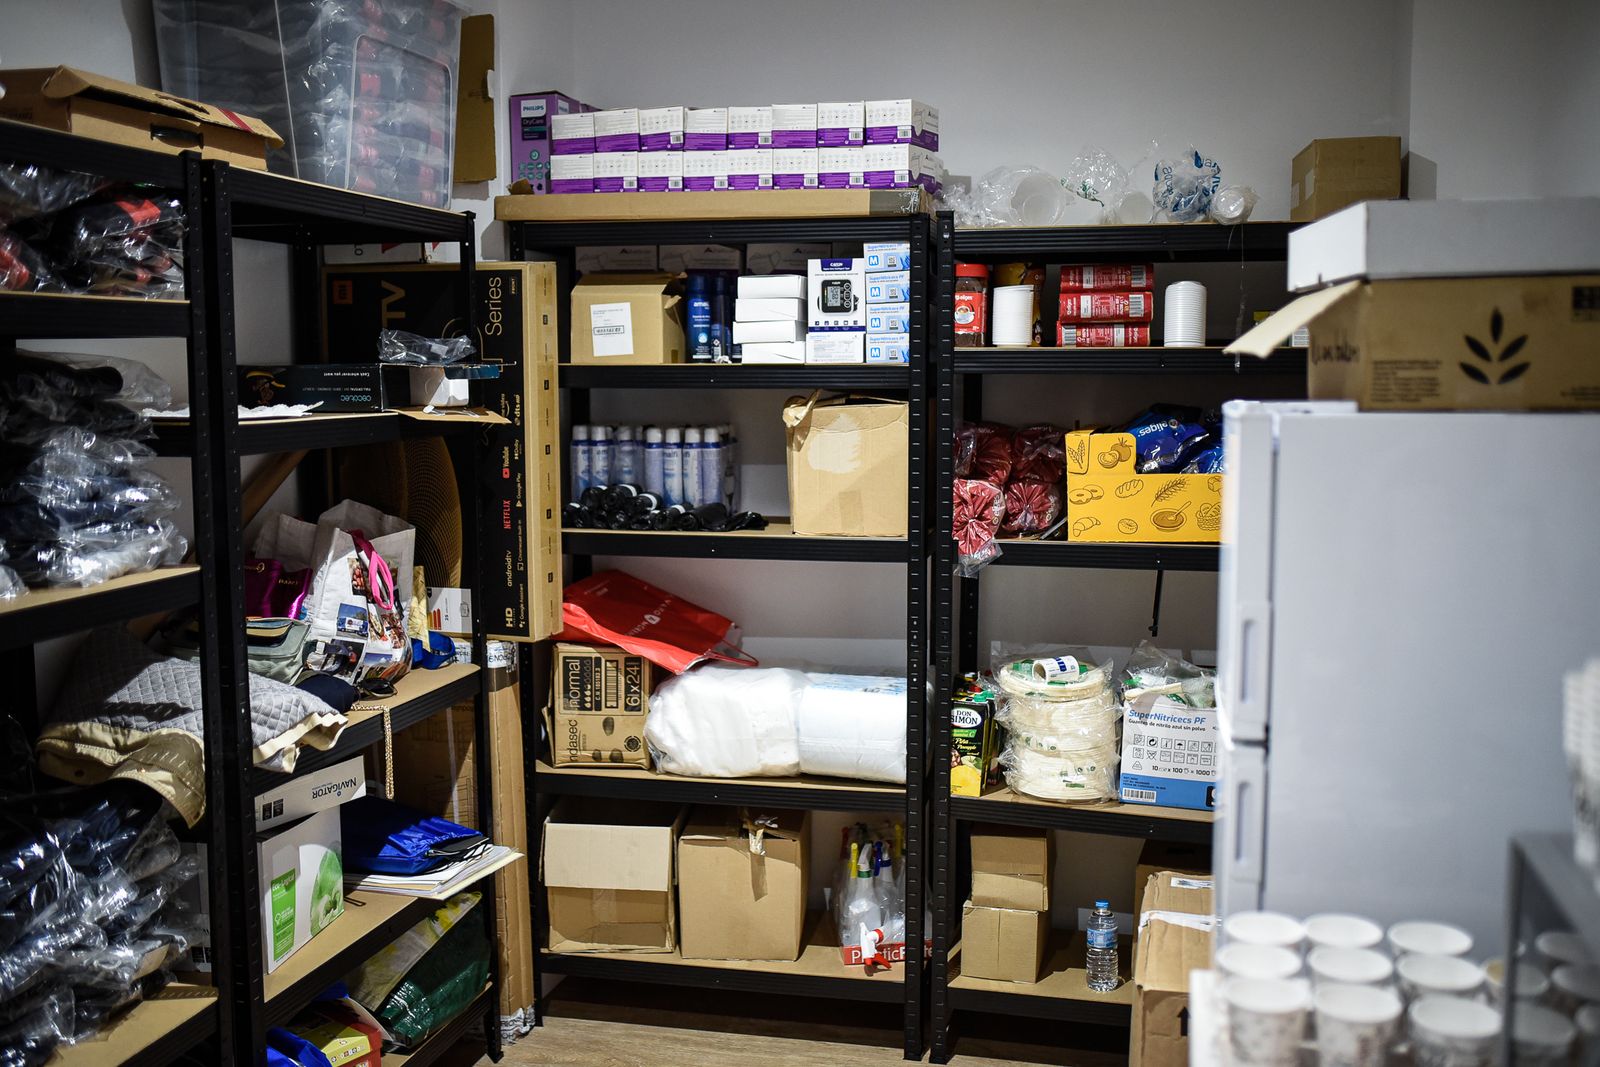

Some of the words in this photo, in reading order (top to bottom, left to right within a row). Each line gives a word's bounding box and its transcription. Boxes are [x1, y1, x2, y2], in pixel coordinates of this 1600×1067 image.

[869, 256, 878, 265] M
[871, 288, 880, 297] M
[382, 279, 406, 328] TV
[484, 277, 502, 337] Series
[871, 318, 880, 327] M
[871, 348, 880, 357] M
[1139, 421, 1168, 436] eliges
[503, 500, 511, 529] NETFLIX
[505, 607, 513, 628] HD
[566, 659, 581, 708] normal
[1128, 709, 1192, 724] SuperNitricecs
[1193, 716, 1207, 725] PF
[312, 777, 357, 800] NAVIGATOR
